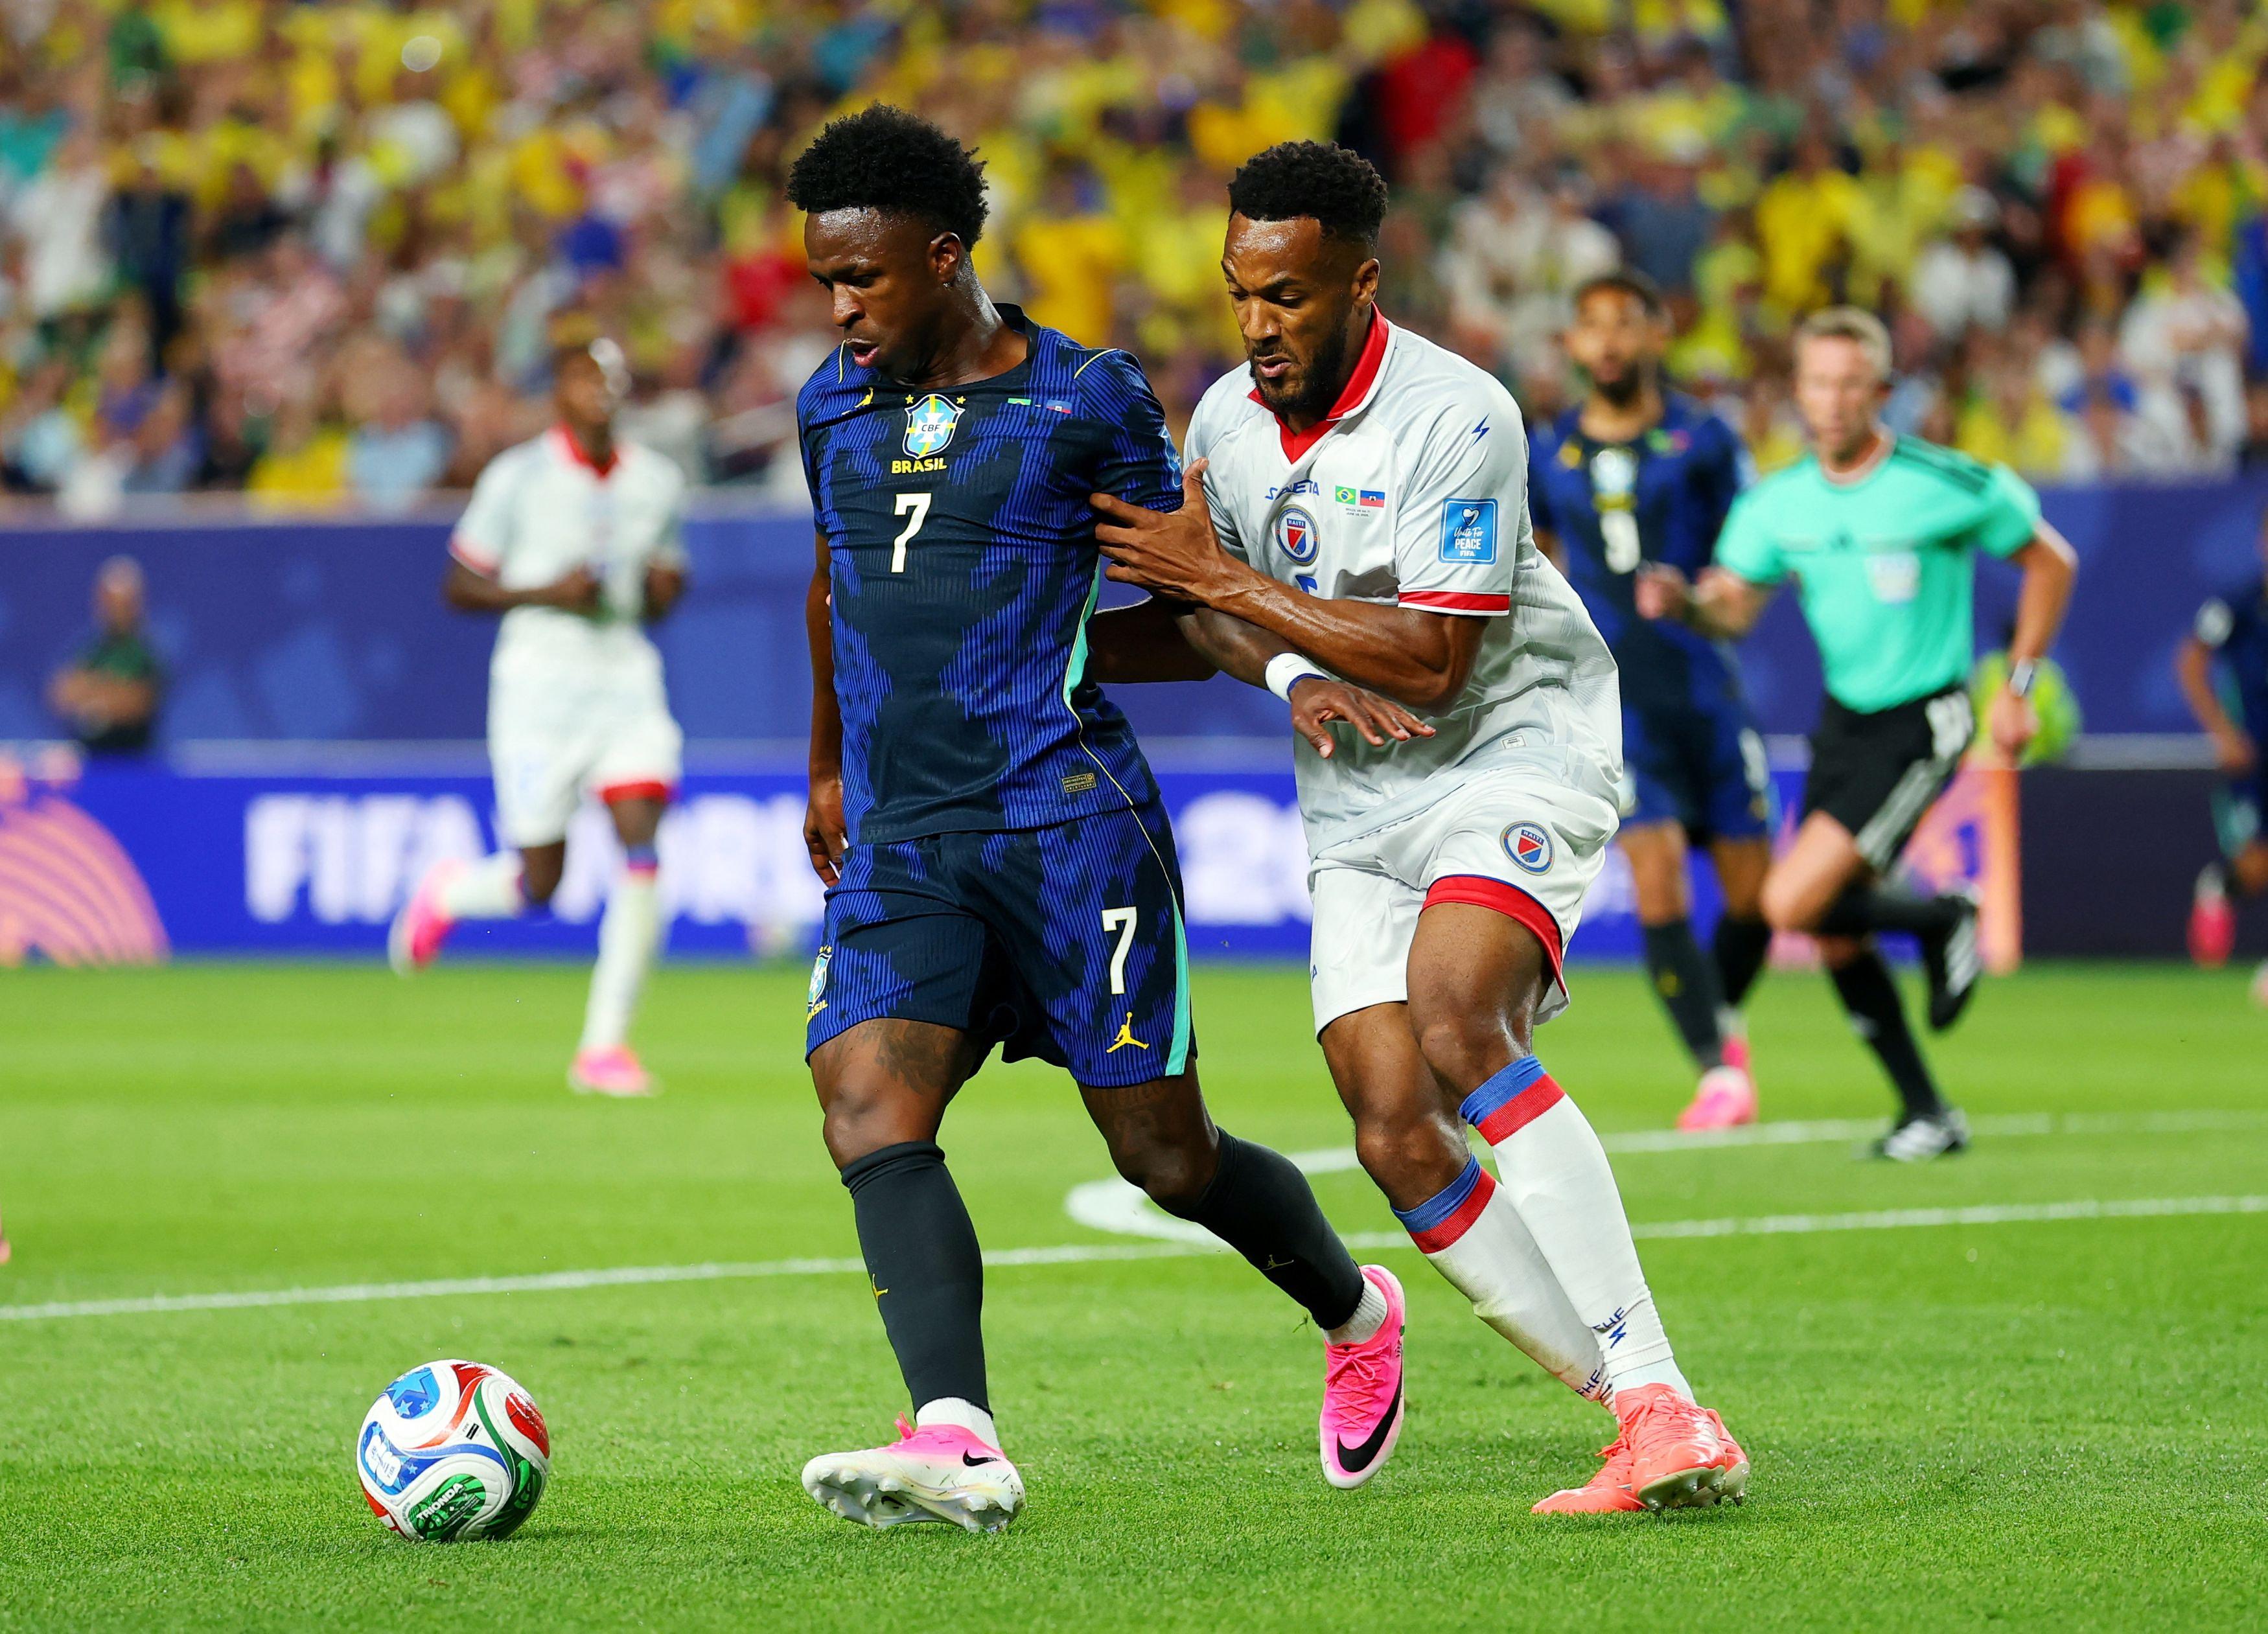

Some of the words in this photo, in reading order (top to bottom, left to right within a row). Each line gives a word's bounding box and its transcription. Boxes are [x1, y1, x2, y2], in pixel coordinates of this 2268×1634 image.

[891, 457, 947, 474] BRASIL
[890, 492, 932, 573] 7
[1453, 526, 1472, 538] Unite
[1472, 526, 1484, 538] For
[1455, 538, 1481, 549] PEACE
[1523, 830, 1543, 844] HAITI
[1101, 906, 1137, 995] 7
[415, 1482, 464, 1521] TRIONDA
